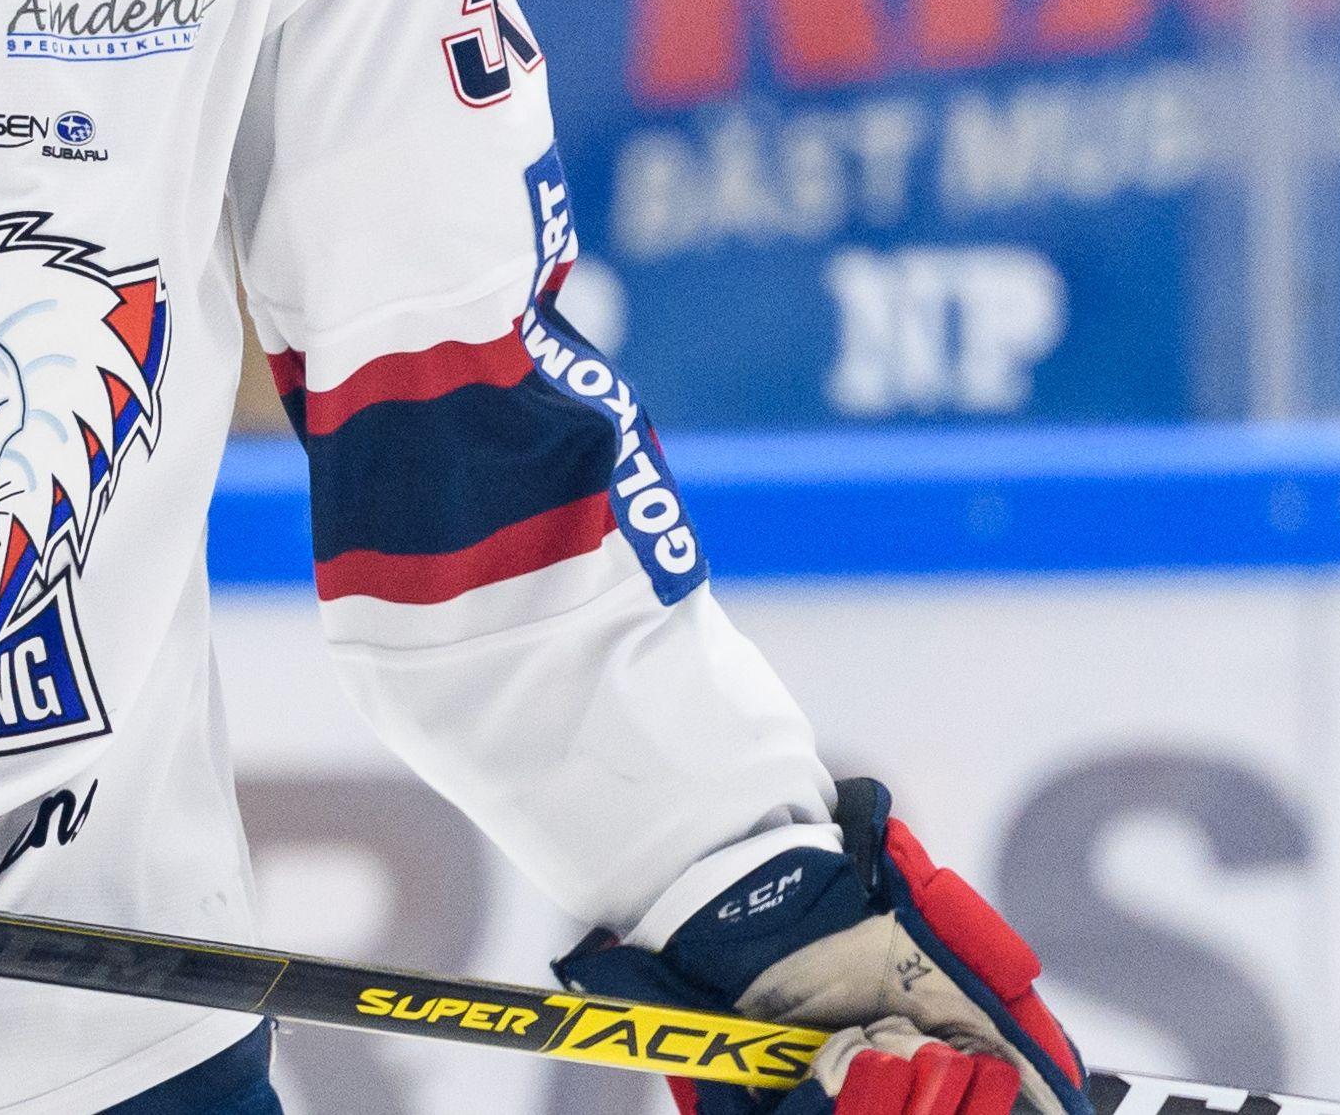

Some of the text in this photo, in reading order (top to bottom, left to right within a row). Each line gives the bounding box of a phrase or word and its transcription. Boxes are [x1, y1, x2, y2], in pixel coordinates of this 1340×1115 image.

[41, 145, 108, 162] SUBARU
[356, 987, 824, 1079] SUPER TACKS
